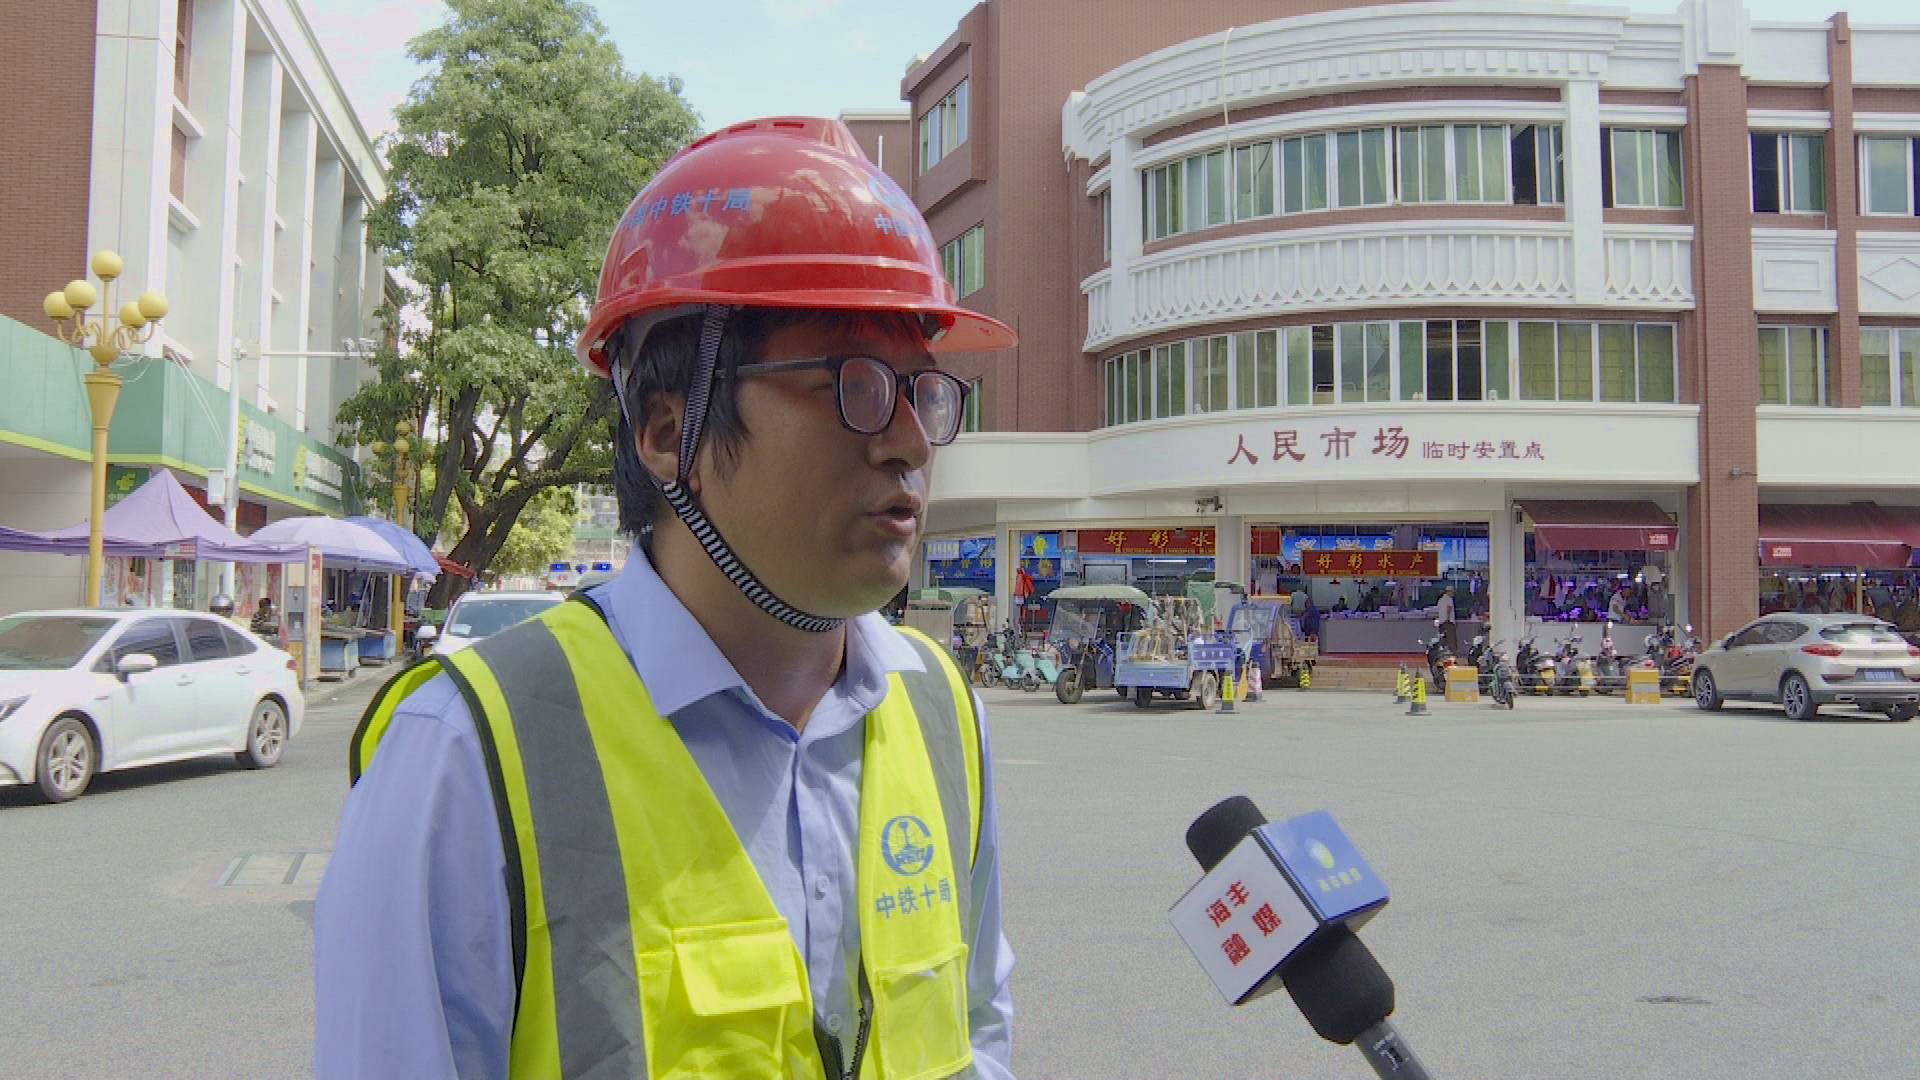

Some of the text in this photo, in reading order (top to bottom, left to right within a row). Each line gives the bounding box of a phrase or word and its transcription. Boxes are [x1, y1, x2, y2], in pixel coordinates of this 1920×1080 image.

[1227, 426, 1410, 466] 人民市场
[1422, 439, 1545, 461] 临时安置点
[1103, 529, 1214, 549] 好彩水
[1316, 553, 1424, 570] 好彩水产
[875, 877, 952, 919] 中铁十局
